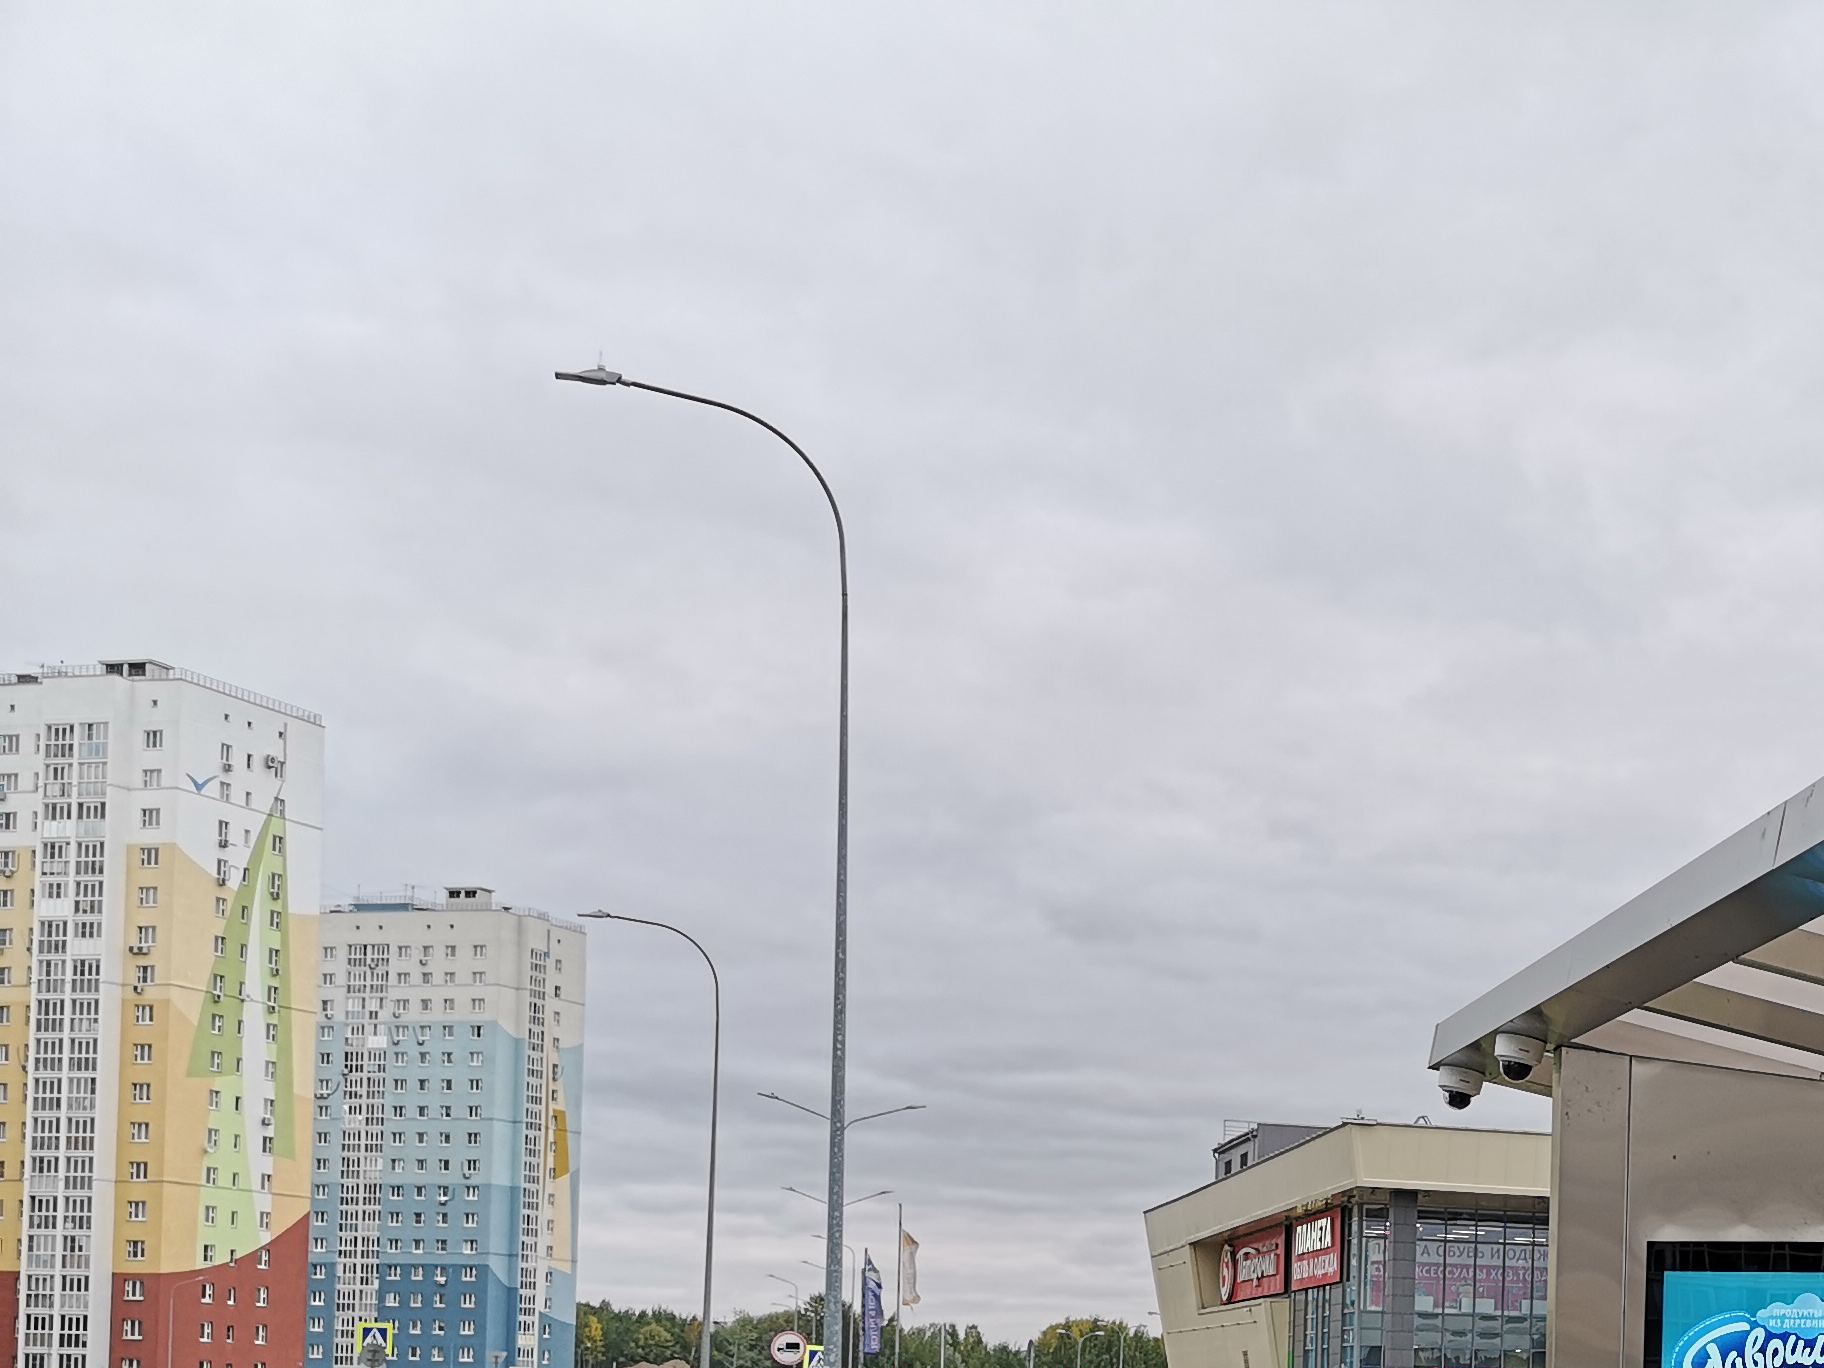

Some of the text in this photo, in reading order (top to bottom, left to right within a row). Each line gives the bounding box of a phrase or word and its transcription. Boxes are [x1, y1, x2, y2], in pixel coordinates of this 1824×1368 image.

[1295, 1217, 1332, 1256] ПЛАНЕТА
[1490, 1247, 1501, 1260] И
[1294, 1260, 1308, 1280] ОБУВЬ
[1314, 1252, 1338, 1279] ОДЕЖДА
[1772, 1308, 1823, 1319] ПРОДУКТЫ
[1769, 1319, 1781, 1327] ИЗ
